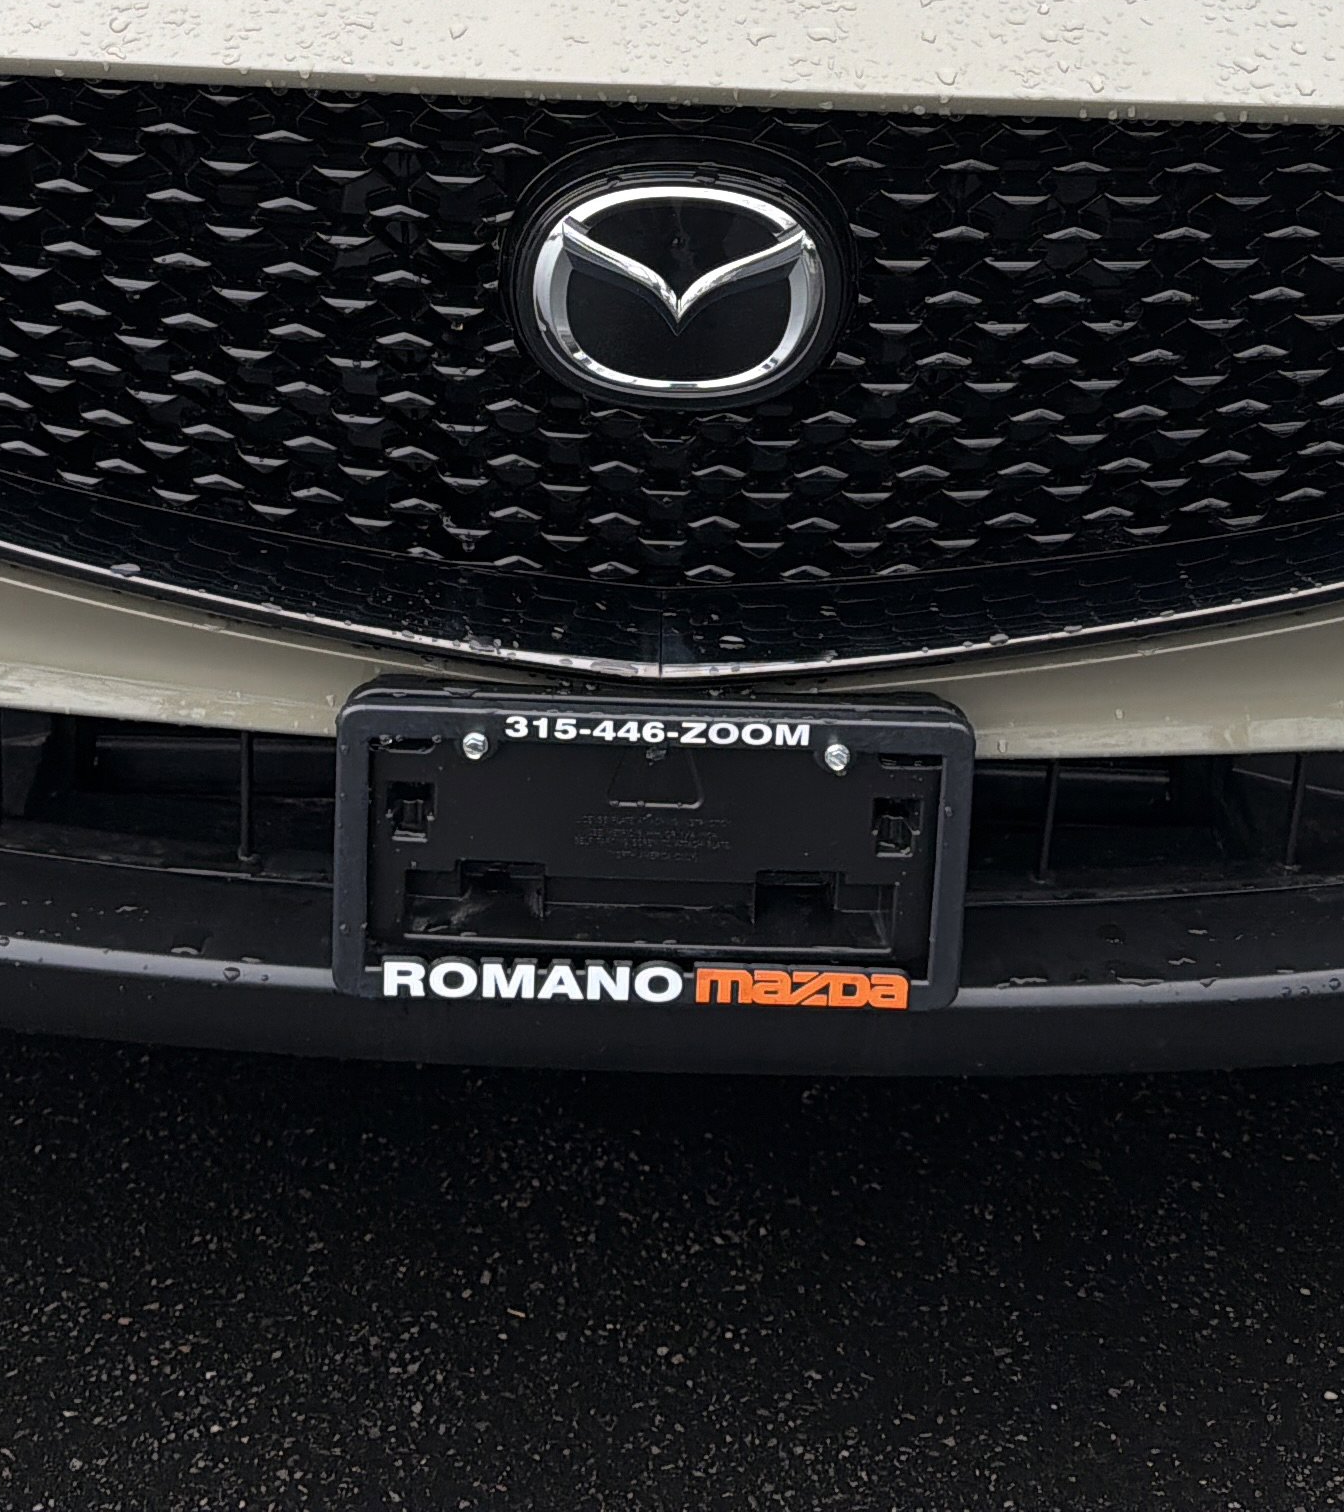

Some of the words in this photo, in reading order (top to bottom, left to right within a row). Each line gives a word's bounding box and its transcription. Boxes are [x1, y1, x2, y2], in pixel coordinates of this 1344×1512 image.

[505, 716, 811, 746] 315-446-ZOOM
[382, 960, 684, 1004] ROMANO
[694, 967, 909, 1010] mazda
